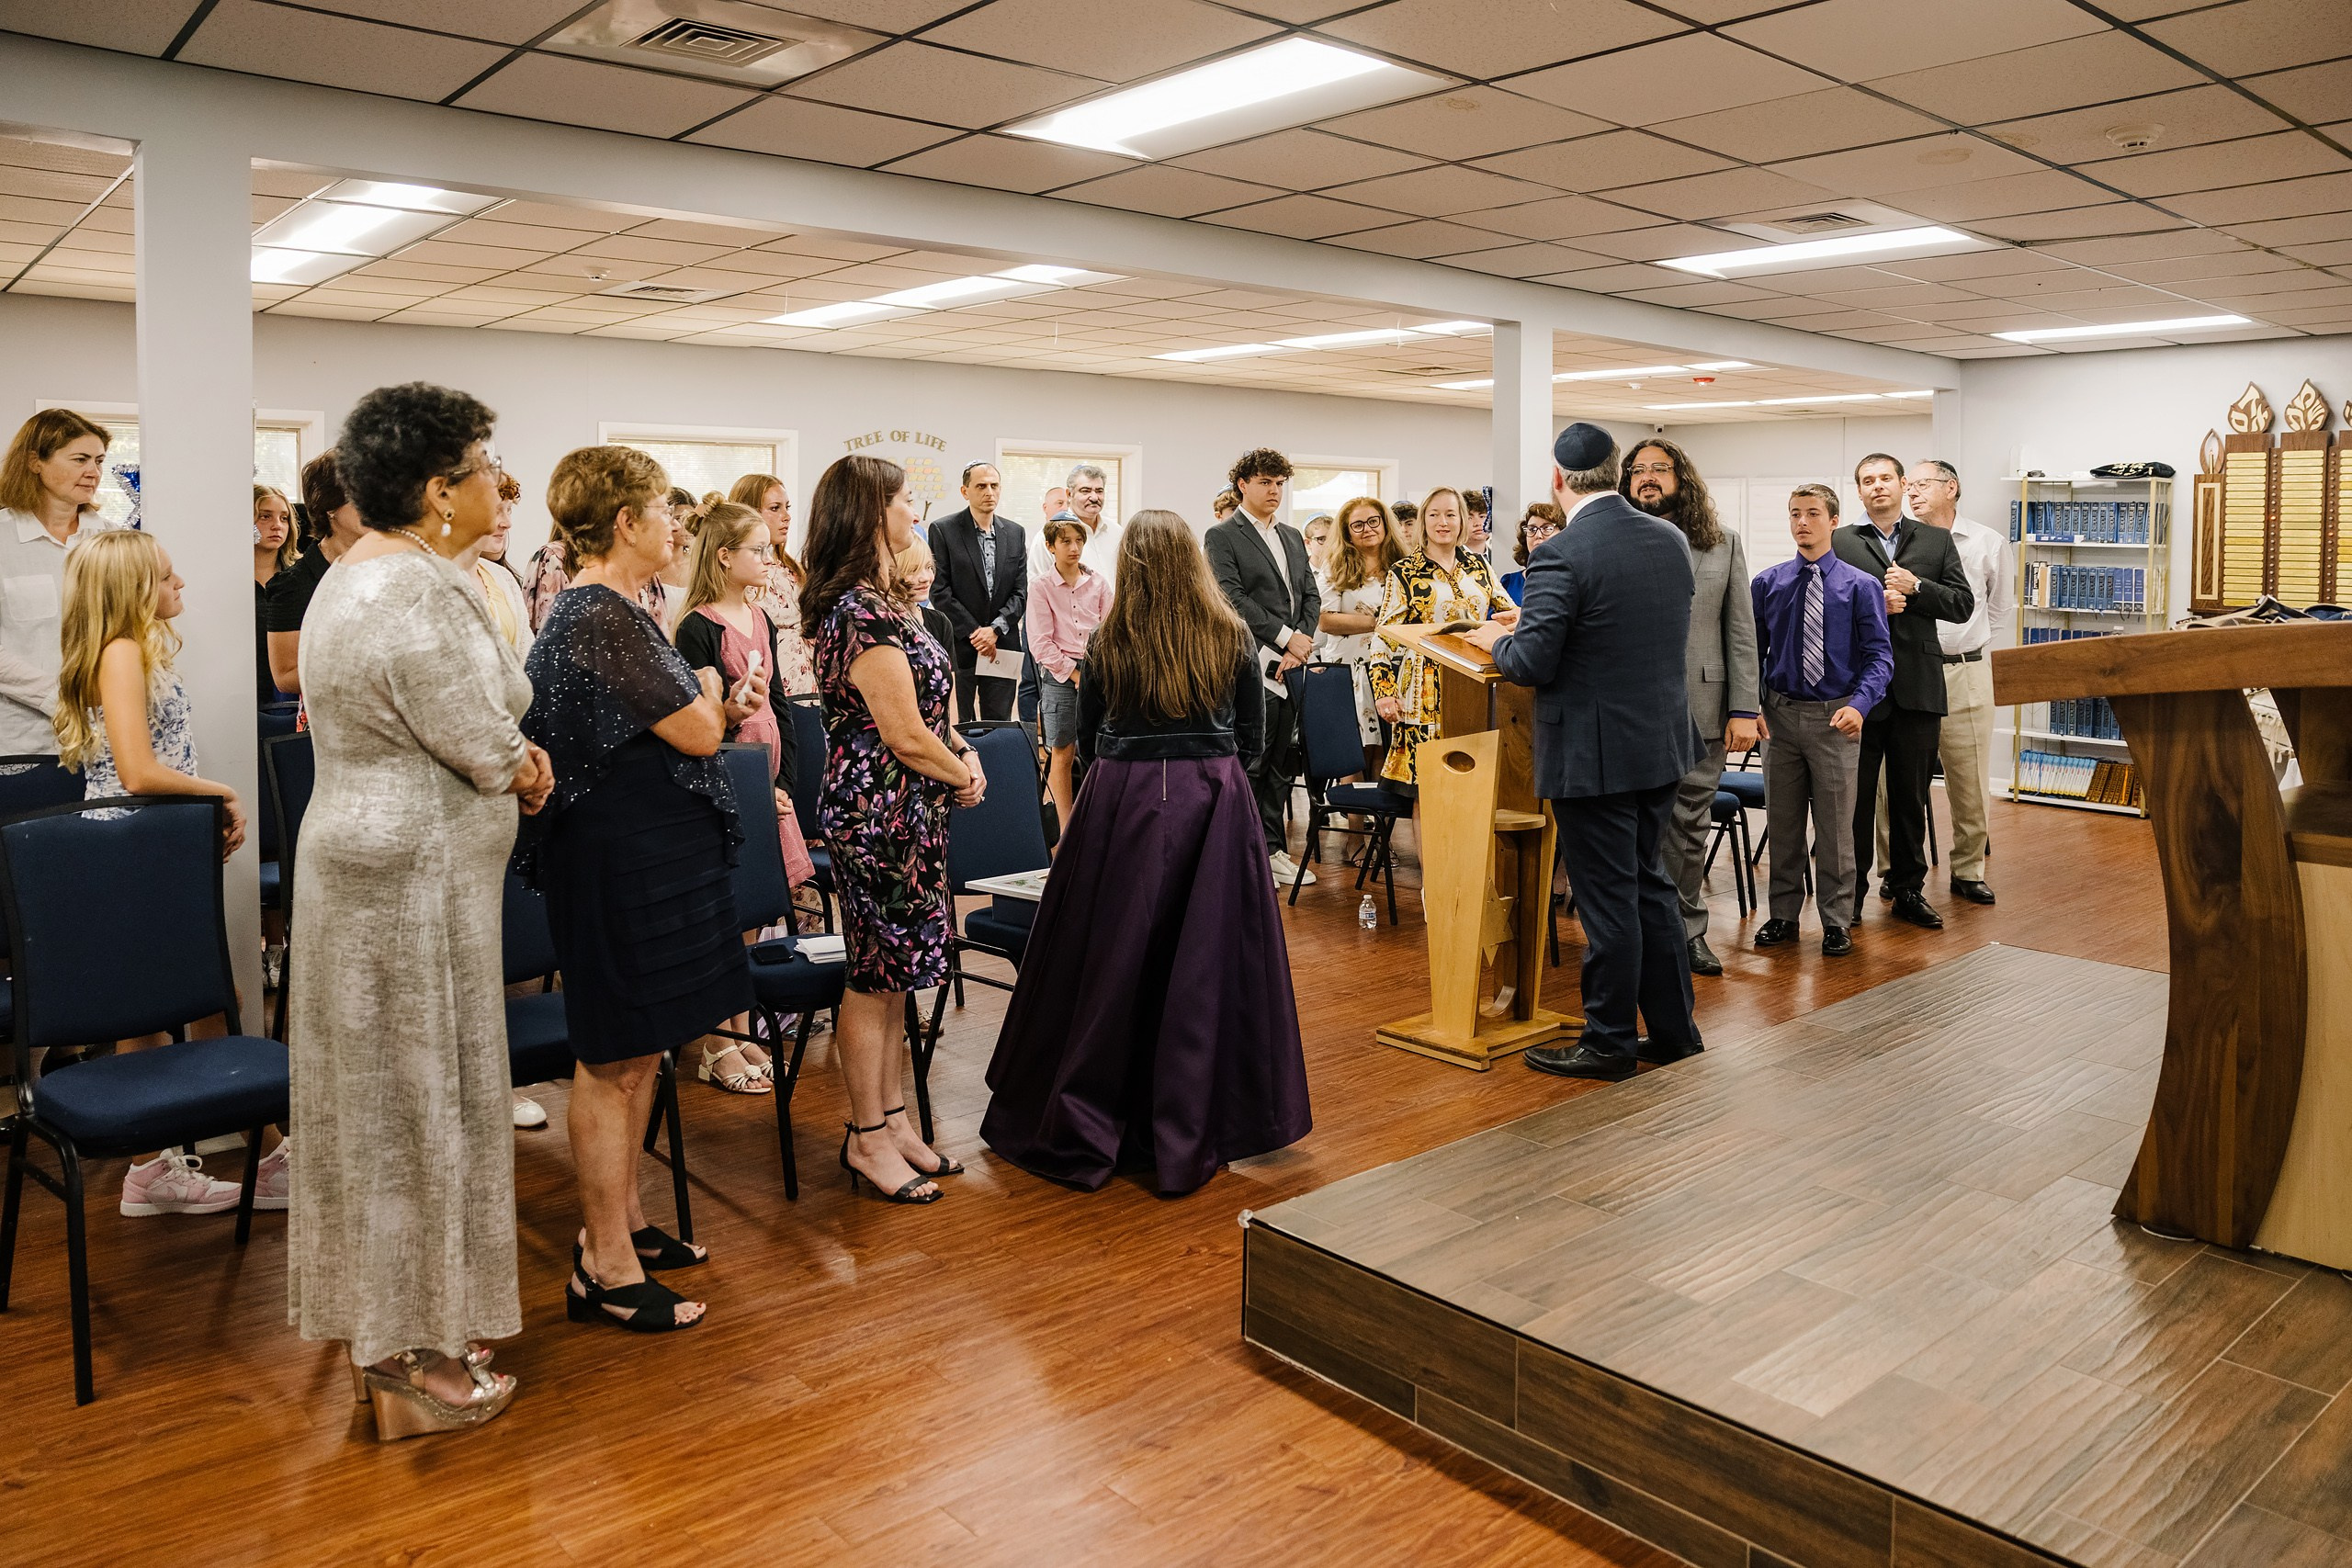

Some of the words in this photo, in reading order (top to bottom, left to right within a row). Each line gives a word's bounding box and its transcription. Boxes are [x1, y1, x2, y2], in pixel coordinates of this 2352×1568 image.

[843, 431, 884, 452] TREE
[889, 430, 910, 442] OF
[915, 432, 947, 452] LIFE
